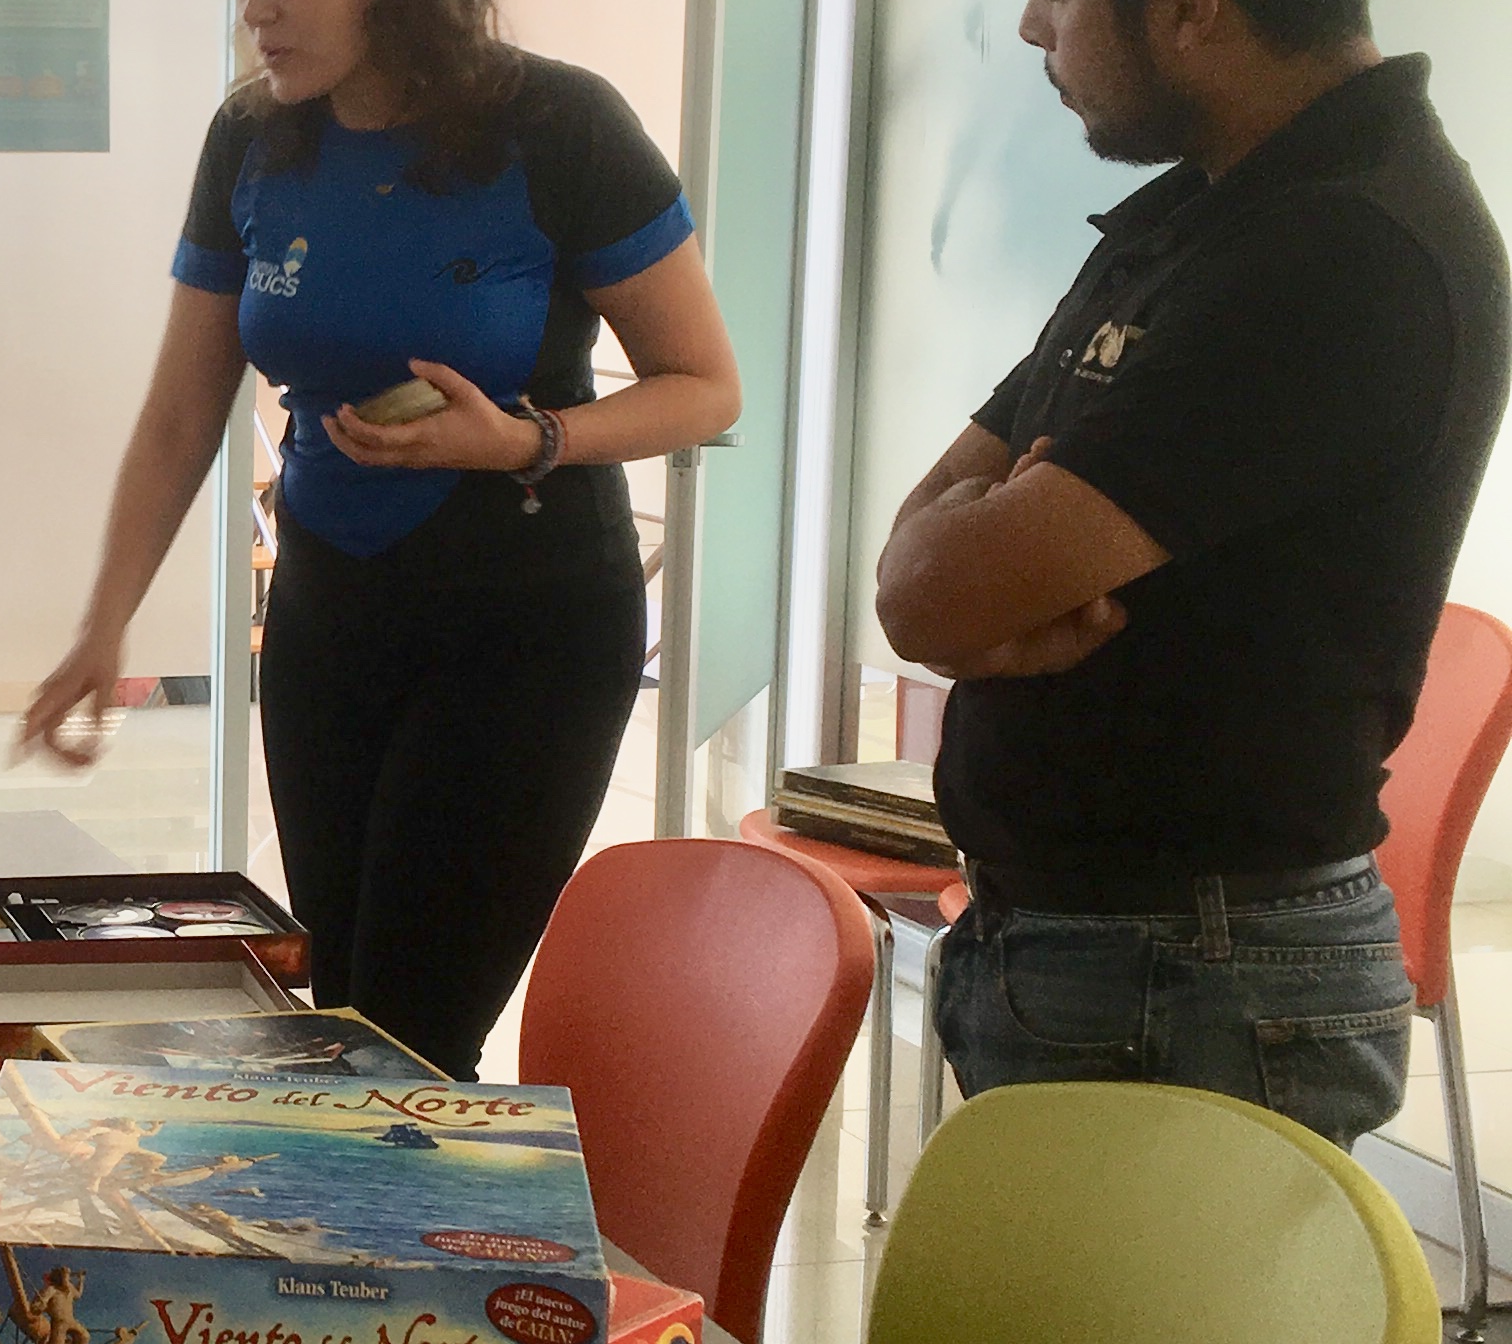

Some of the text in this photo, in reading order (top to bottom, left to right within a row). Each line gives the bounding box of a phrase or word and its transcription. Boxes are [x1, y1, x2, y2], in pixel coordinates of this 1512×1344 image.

[249, 272, 300, 298] CUCS
[54, 1068, 535, 1127] Viento del Norte
[278, 1277, 389, 1301] Klaus Teuber
[494, 1297, 587, 1331] juego del autor
[535, 1294, 573, 1312] nuevo
[499, 1315, 516, 1329] de
